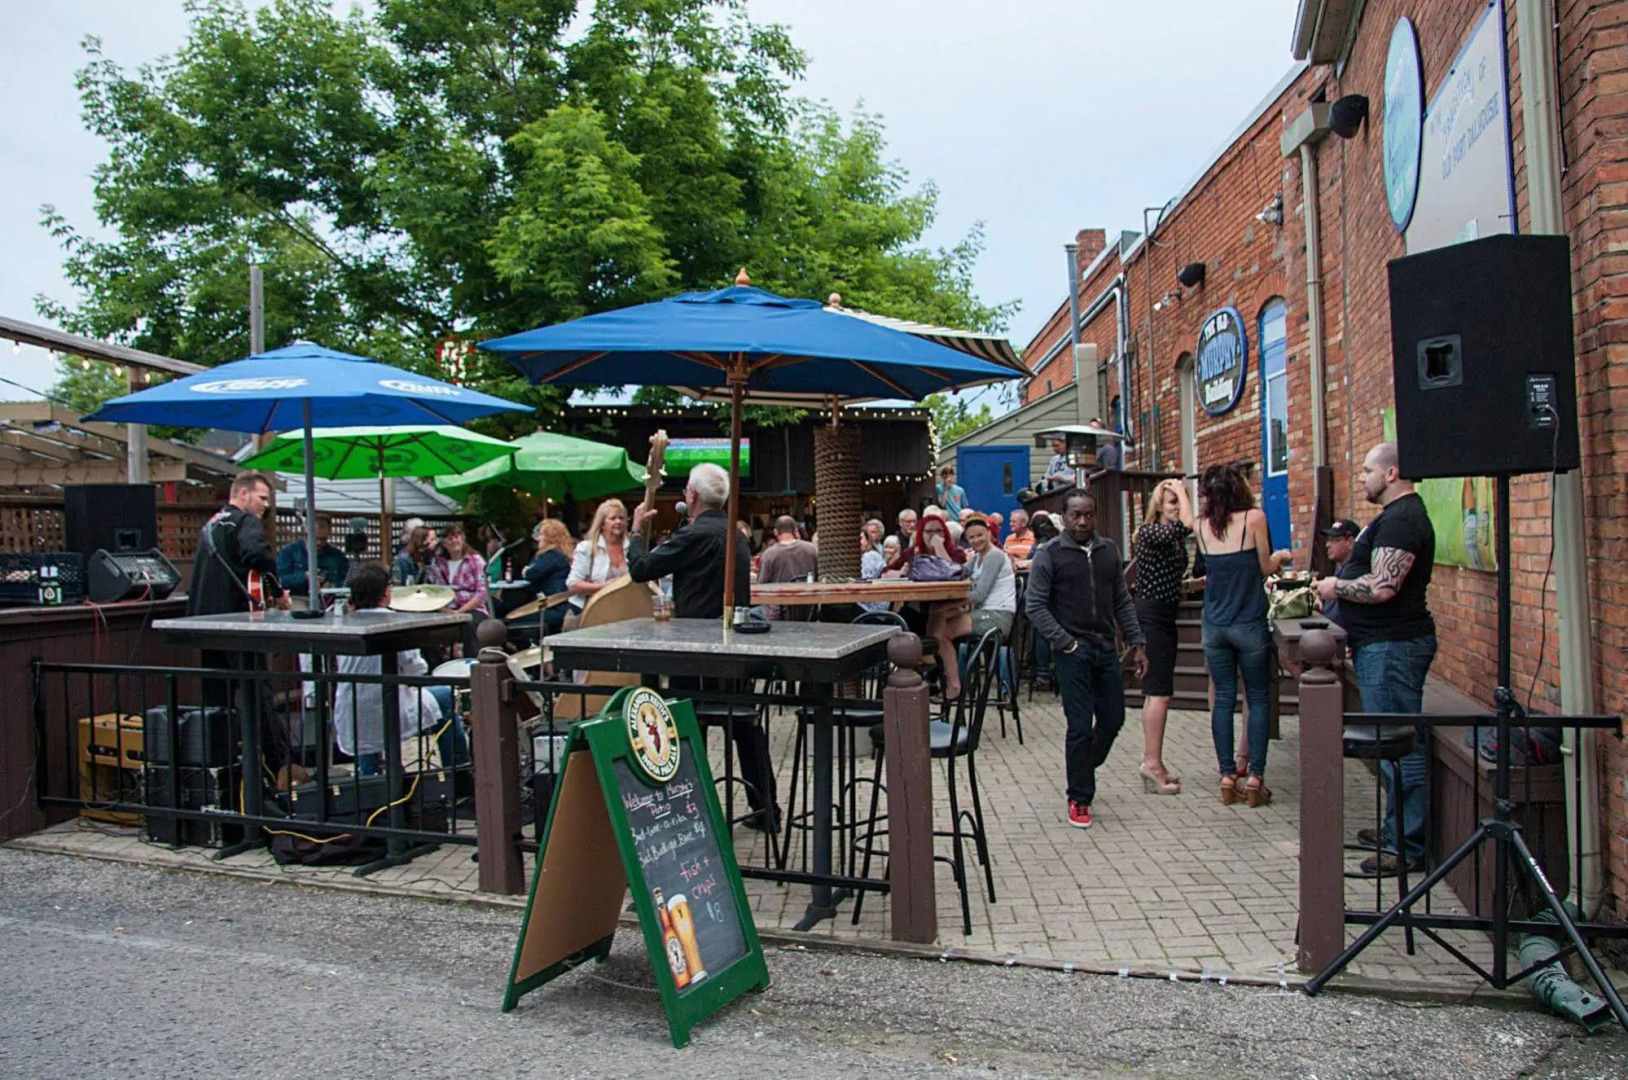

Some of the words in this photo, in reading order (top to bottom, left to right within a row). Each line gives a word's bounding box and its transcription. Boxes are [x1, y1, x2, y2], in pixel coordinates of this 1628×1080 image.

[1201, 332, 1236, 382] MURPHY
[1204, 377, 1233, 405] Building
[630, 693, 650, 730] ALEXANDER
[641, 754, 661, 776] INDIA
[661, 760, 675, 776] PALE
[622, 792, 654, 809] Welcome
[655, 789, 664, 801] to
[647, 803, 671, 816] Patio
[680, 857, 702, 882] Fish
